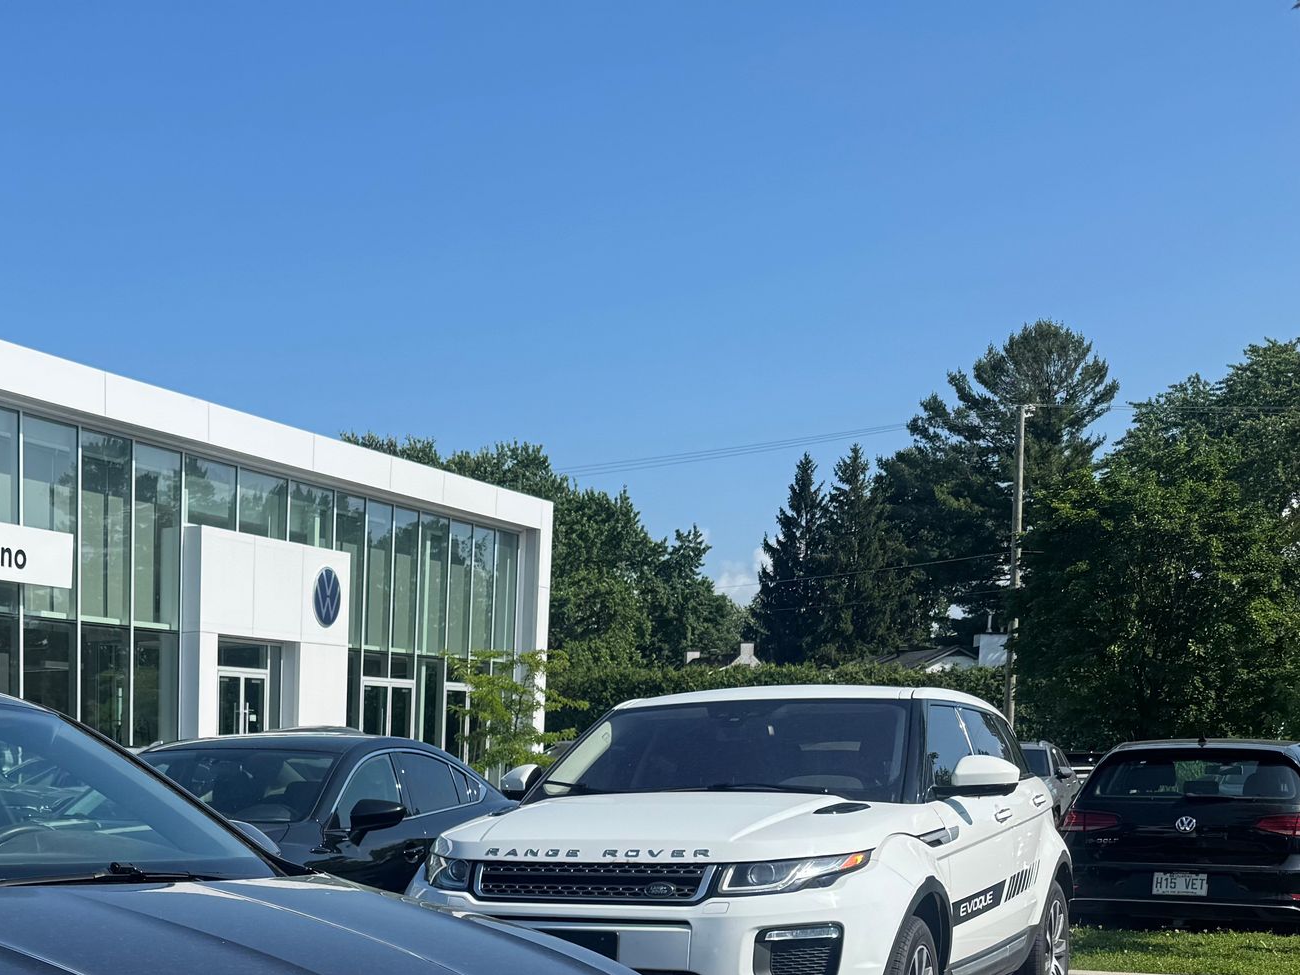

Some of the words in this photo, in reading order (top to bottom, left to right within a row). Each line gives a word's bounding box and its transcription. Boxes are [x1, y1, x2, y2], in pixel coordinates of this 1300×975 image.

[484, 847, 580, 858] RANGE
[602, 848, 711, 859] ROVER
[1155, 876, 1177, 889] H15
[1184, 877, 1206, 890] VET
[960, 890, 993, 917] EVOQUE
